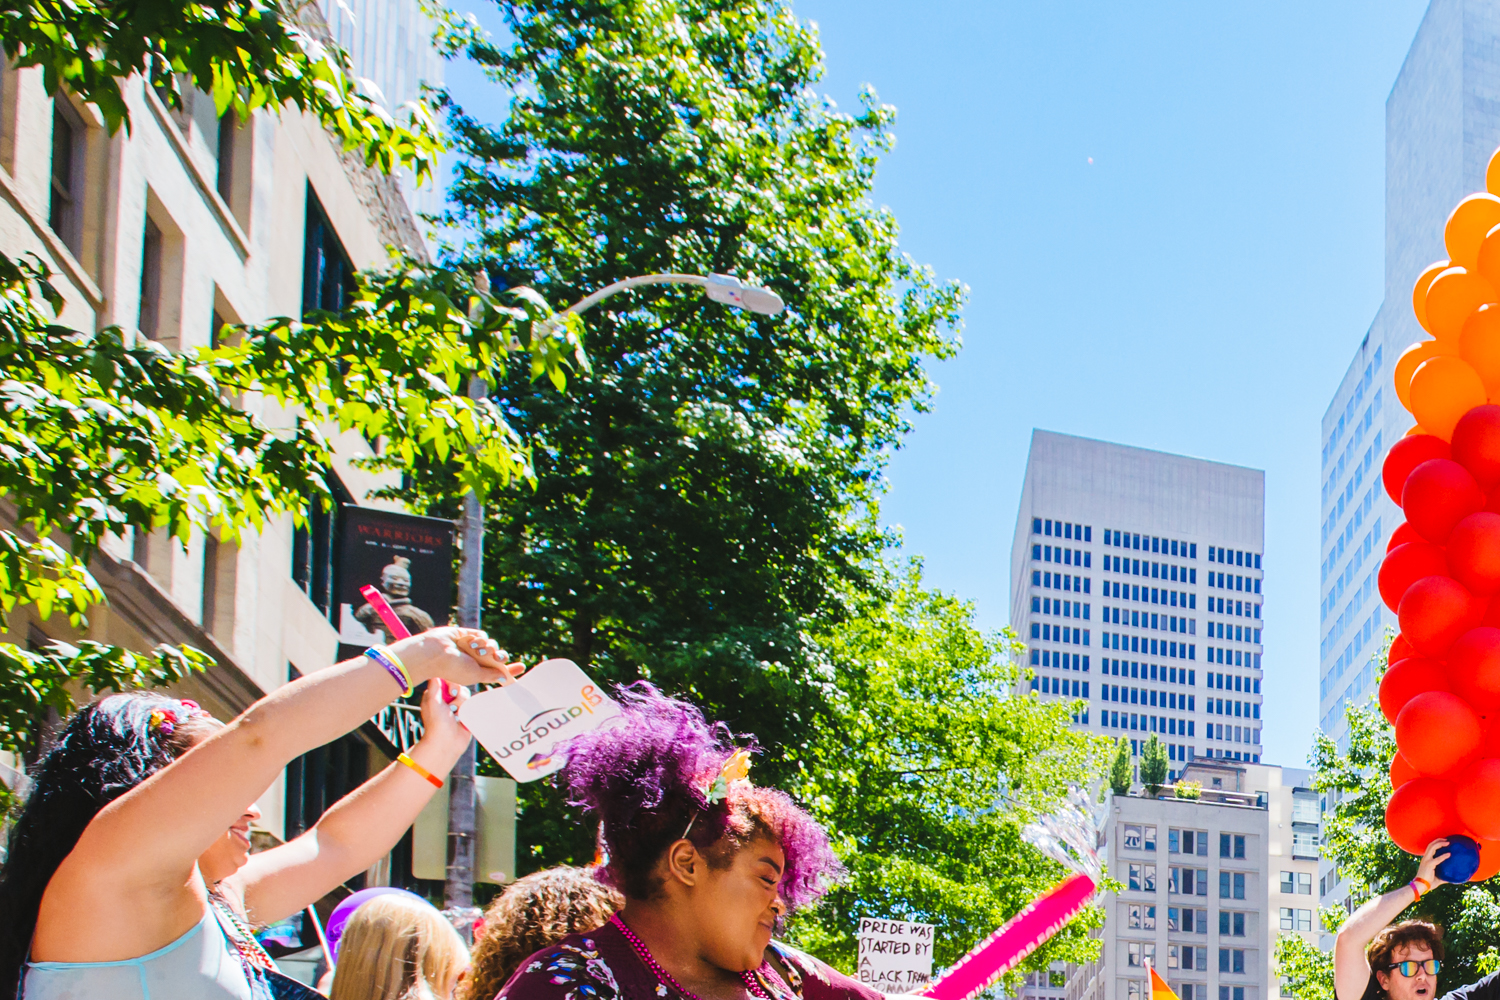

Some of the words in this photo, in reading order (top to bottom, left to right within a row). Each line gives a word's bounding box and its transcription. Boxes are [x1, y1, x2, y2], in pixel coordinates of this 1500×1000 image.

[358, 525, 442, 545] WARRIORS
[388, 664, 408, 688] Center
[494, 685, 603, 759] glamazon
[863, 920, 904, 935] PRIDE
[910, 926, 932, 940] WAS
[861, 937, 910, 955] STARTED
[916, 943, 931, 956] BY
[860, 956, 872, 972] A
[861, 970, 902, 982] BLACK
